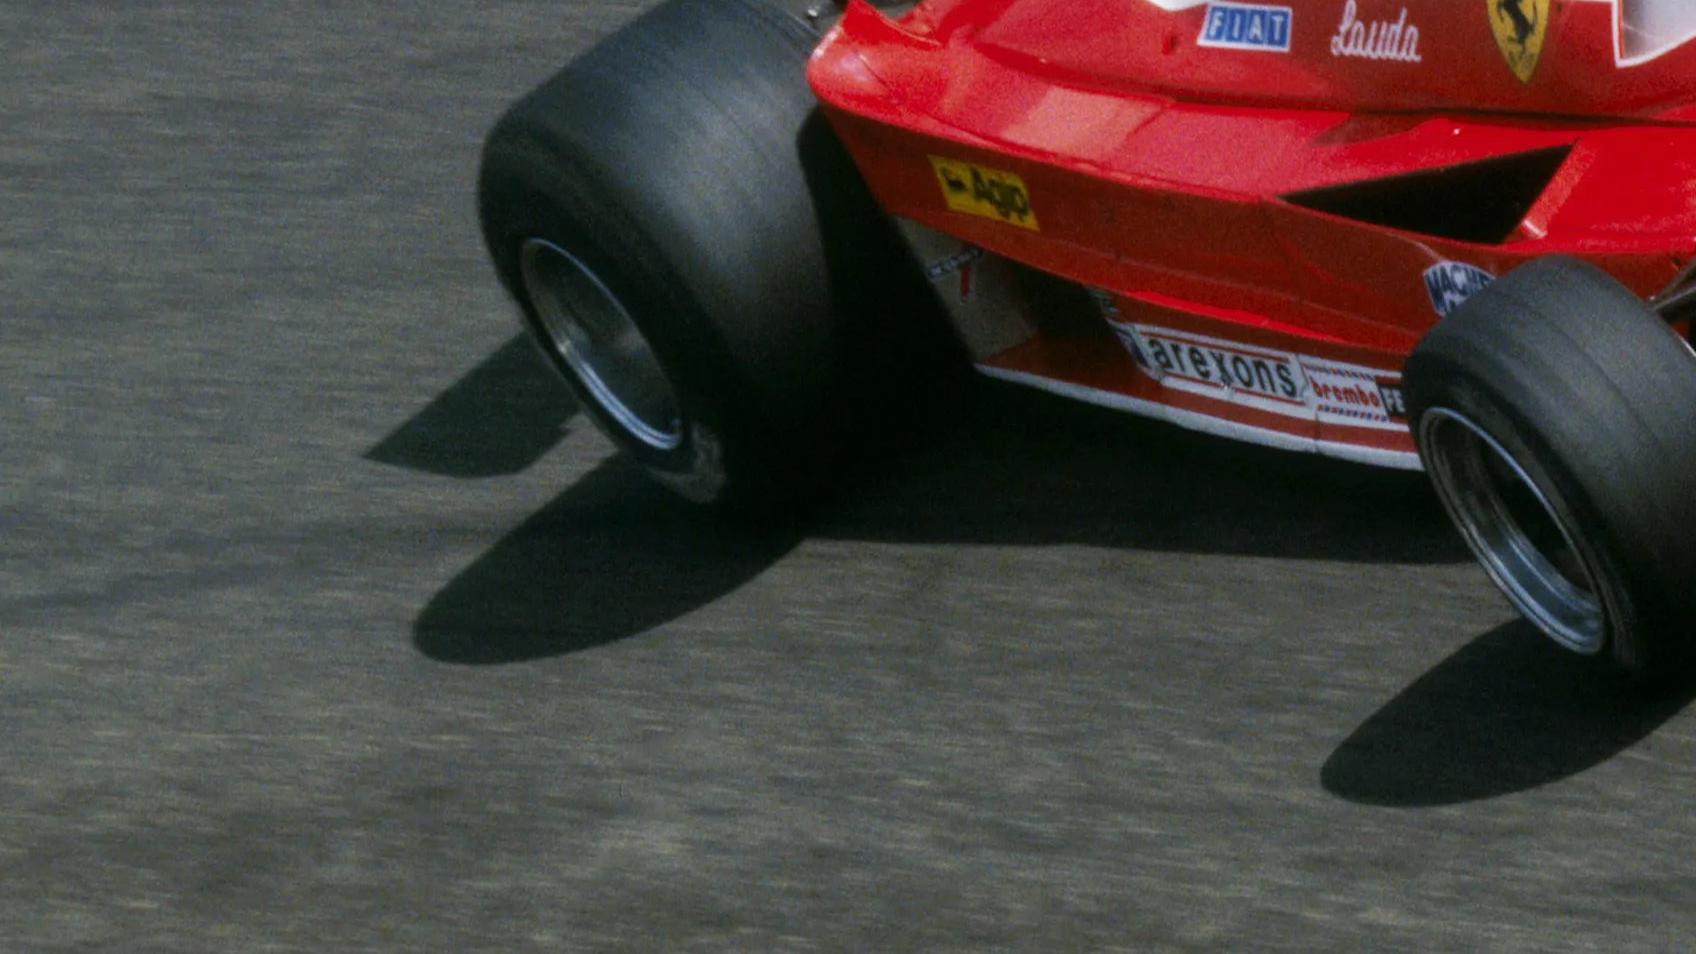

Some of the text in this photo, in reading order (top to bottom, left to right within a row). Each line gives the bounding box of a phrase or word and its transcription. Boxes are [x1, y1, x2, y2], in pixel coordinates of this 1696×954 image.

[1206, 3, 1284, 42] FIAT
[1149, 337, 1299, 399] arexons
[1310, 376, 1380, 409] brembo
